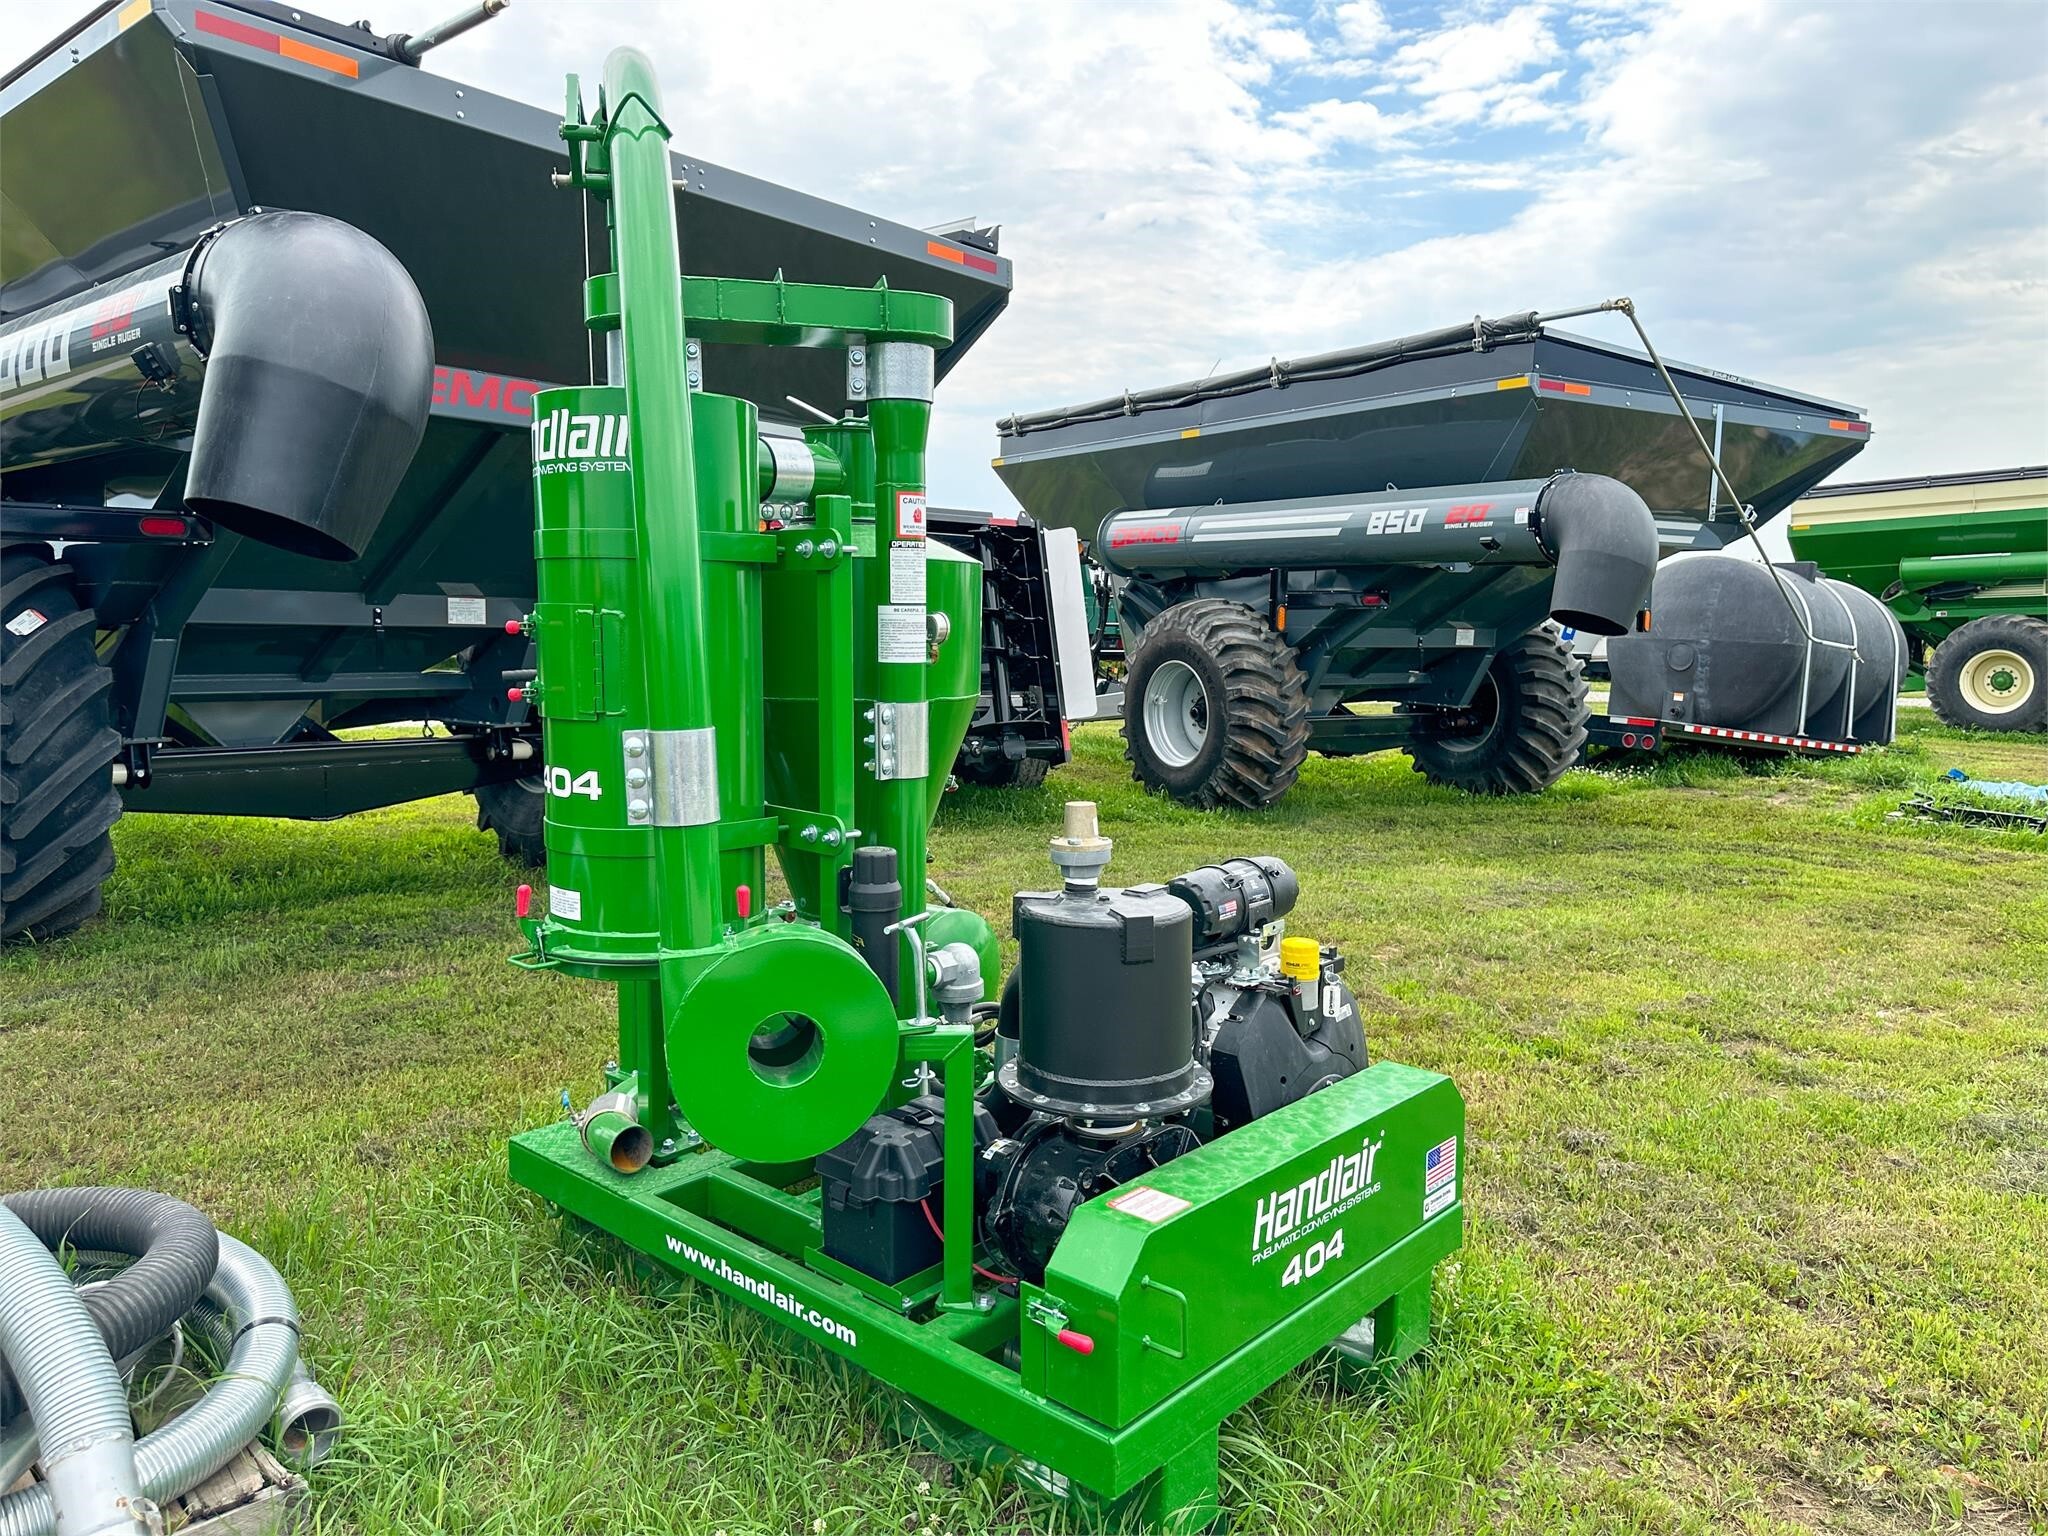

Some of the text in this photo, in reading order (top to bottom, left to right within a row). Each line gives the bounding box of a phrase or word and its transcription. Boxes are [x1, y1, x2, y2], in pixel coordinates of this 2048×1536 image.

[92, 327, 141, 353] SINGLE AUGER
[1111, 525, 1179, 549] DEMCO
[1366, 508, 1429, 535] 850
[1444, 522, 1469, 530] SINGLE
[544, 764, 603, 801] 404
[1252, 1137, 1382, 1252] Handlair
[1252, 1228, 1301, 1266] PNEUMATIC
[1301, 1200, 1347, 1238] CONVEYING
[1346, 1182, 1381, 1210] SYSTEMS
[1281, 1228, 1345, 1288] 404
[665, 1234, 857, 1348] www.handlair.com
